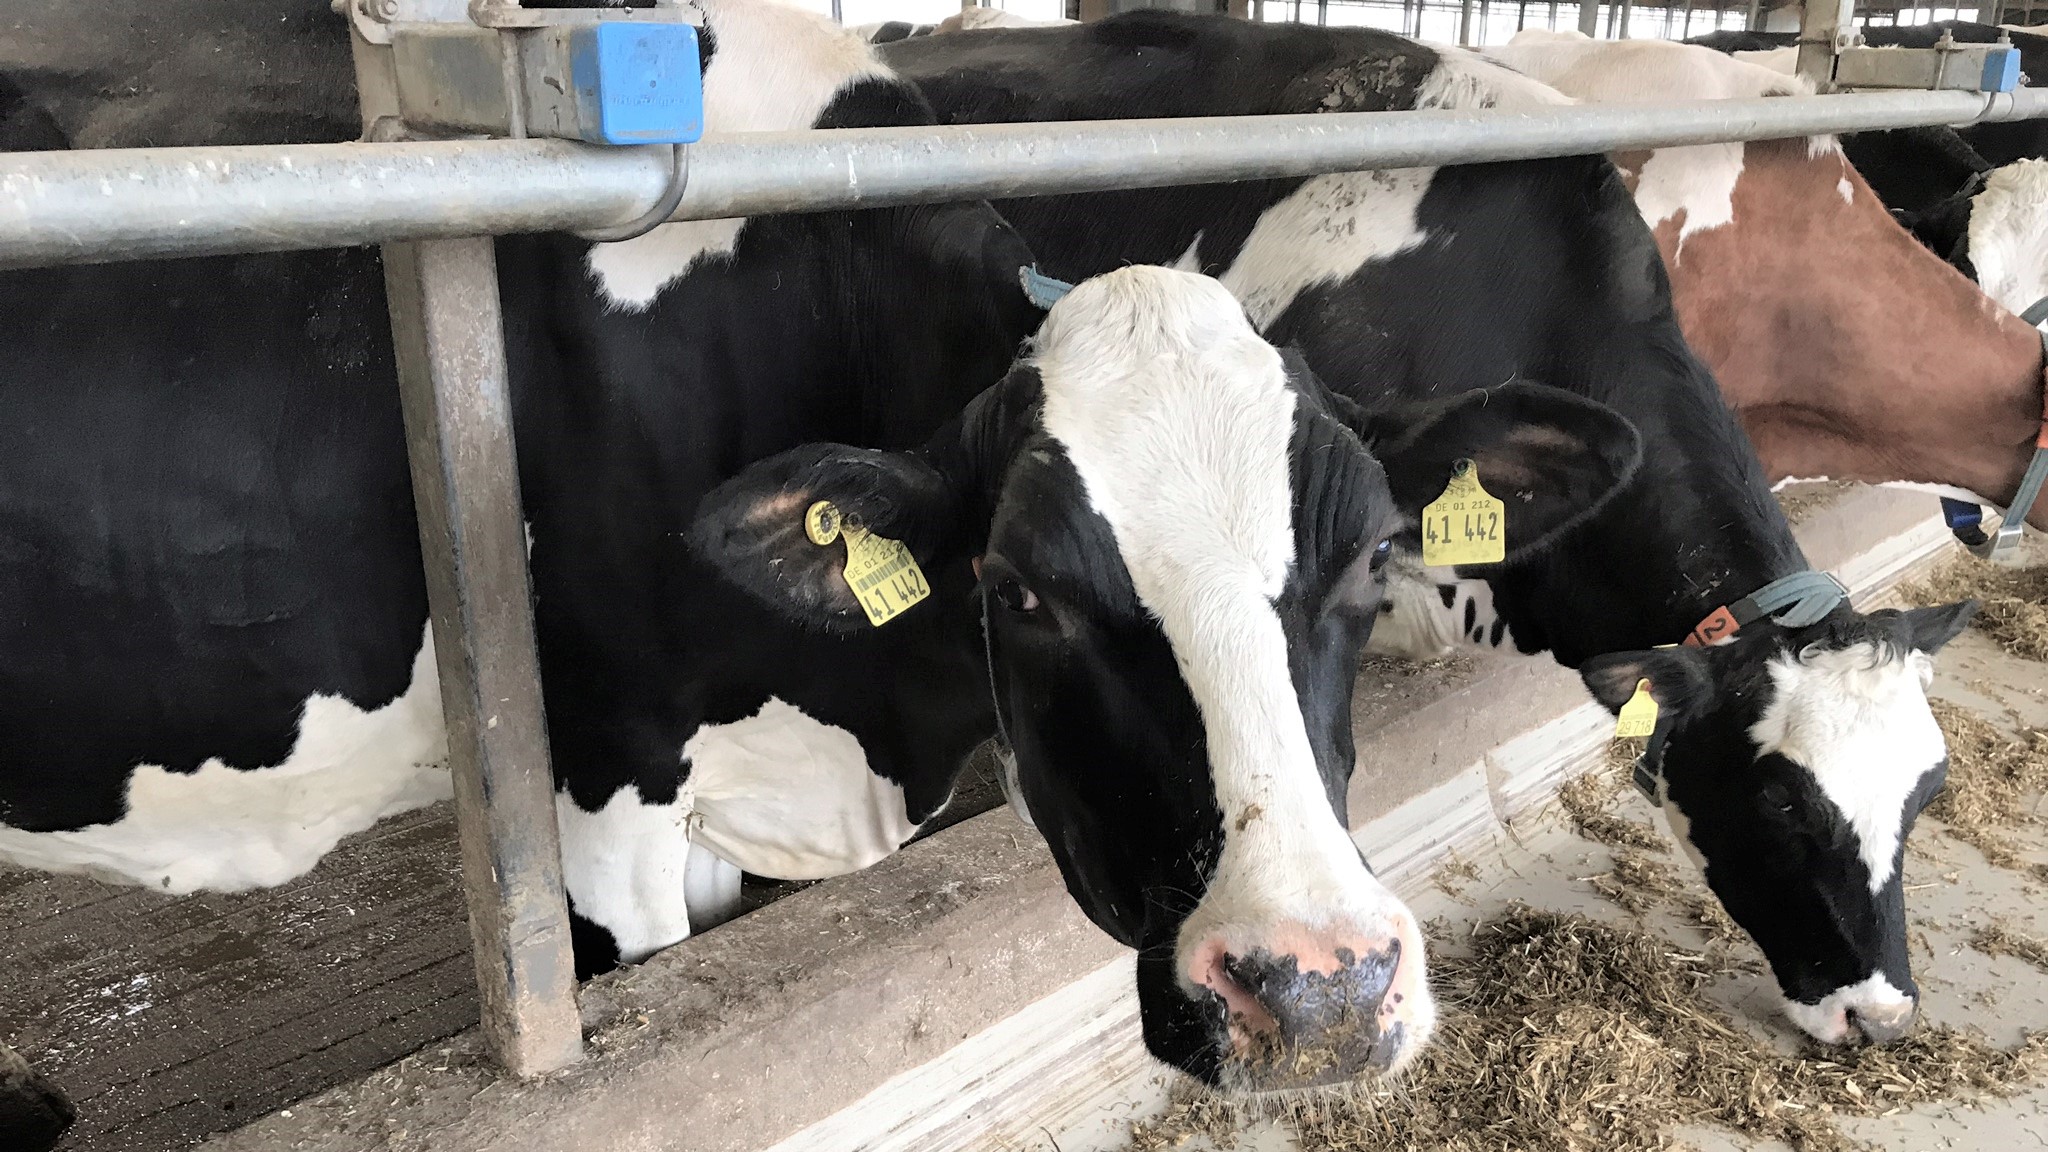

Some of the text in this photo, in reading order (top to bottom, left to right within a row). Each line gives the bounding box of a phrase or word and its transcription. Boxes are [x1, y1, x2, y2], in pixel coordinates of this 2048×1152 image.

[1436, 499, 1491, 512] DE 01 212
[1426, 511, 1498, 544] 41 442
[847, 566, 863, 580] DE
[864, 558, 879, 570] 01
[863, 568, 926, 620] 41 442
[1617, 719, 1652, 735] 29 718
